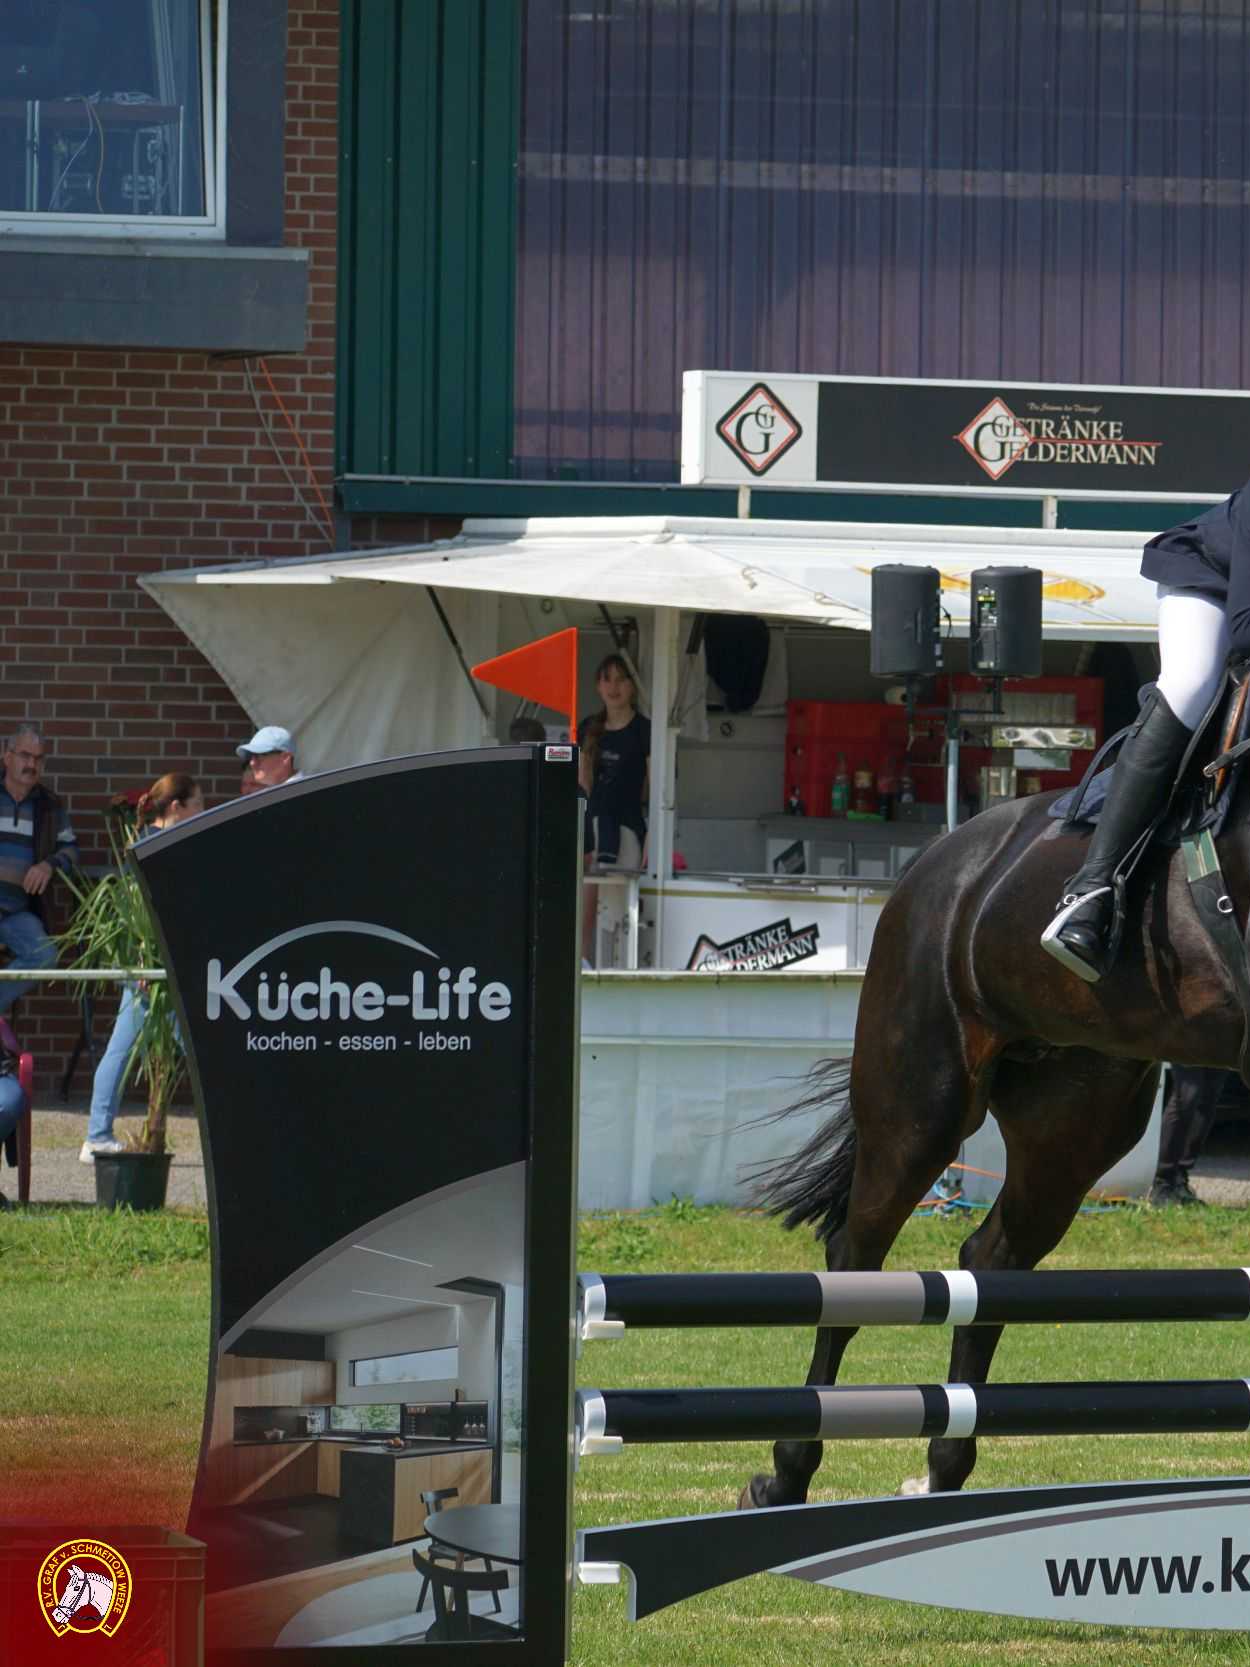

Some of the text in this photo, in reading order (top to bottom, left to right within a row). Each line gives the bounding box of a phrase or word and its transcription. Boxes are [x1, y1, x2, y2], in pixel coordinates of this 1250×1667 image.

[973, 421, 1156, 466] GELDERMANN
[991, 415, 1124, 441] GETRÄNKE
[206, 957, 512, 1021] Küche-Life
[246, 1031, 317, 1051] kochen
[338, 1033, 397, 1051] essen
[418, 1031, 471, 1051] leben
